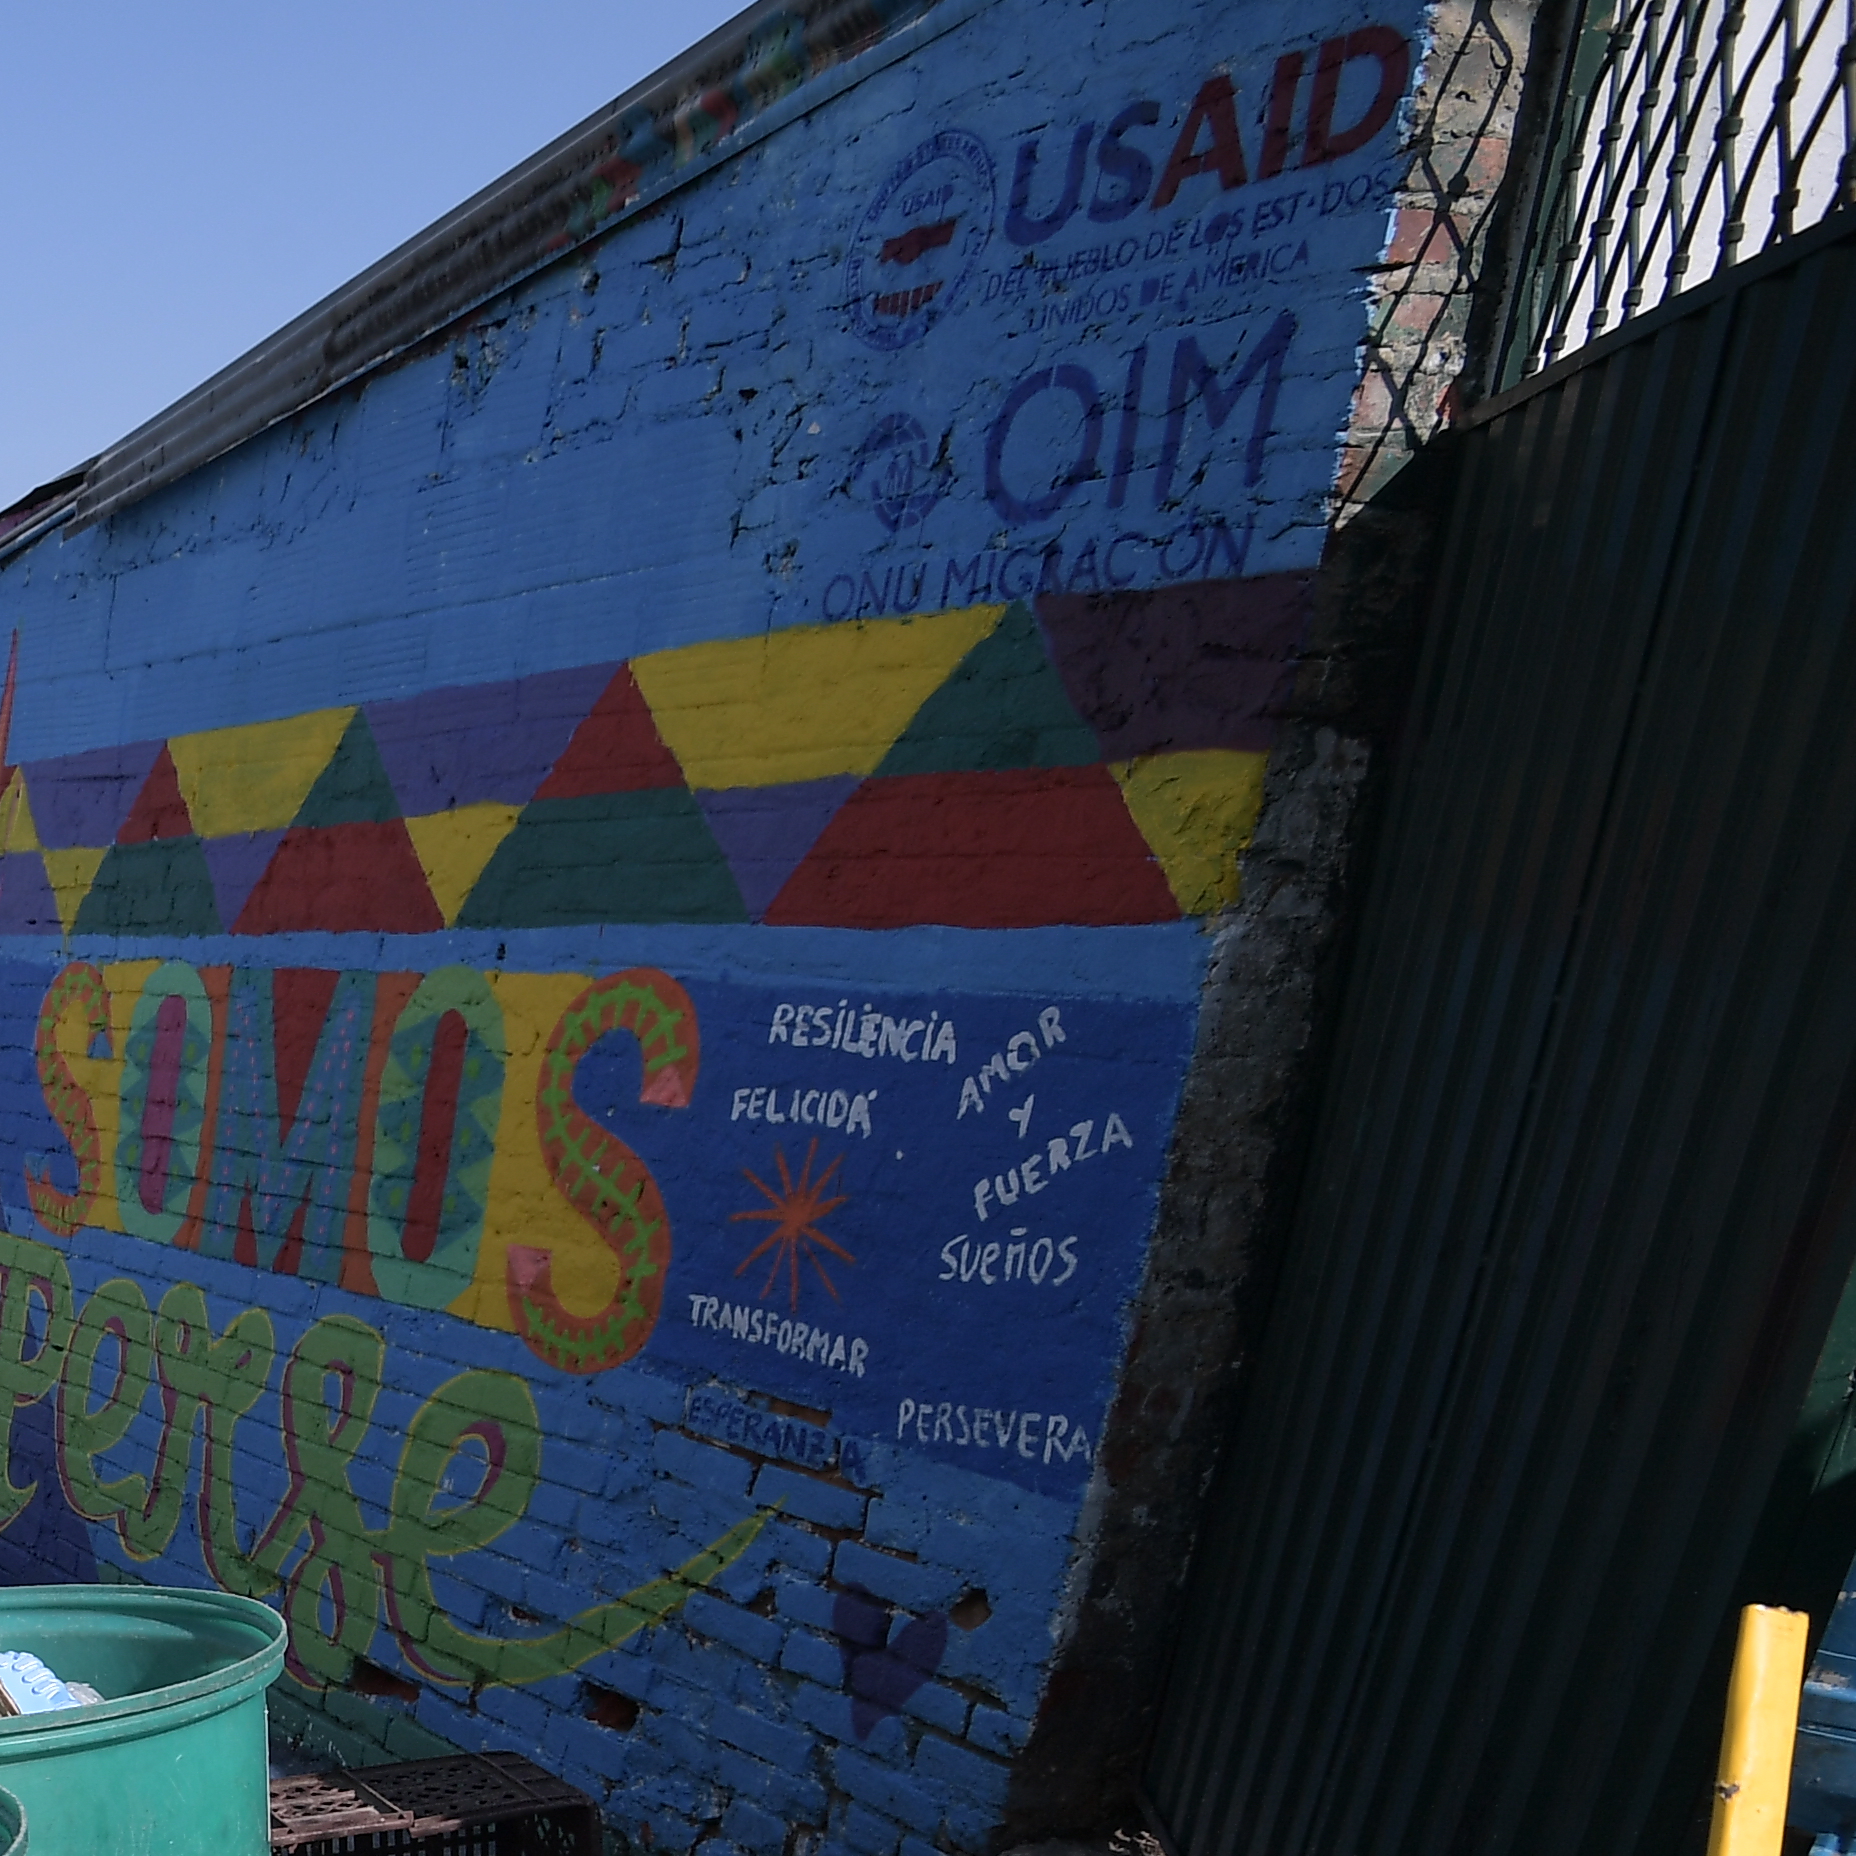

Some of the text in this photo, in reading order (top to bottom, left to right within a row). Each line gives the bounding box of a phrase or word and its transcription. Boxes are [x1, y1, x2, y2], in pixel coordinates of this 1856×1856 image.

[1003, 24, 1412, 247] USAID
[1143, 229, 1184, 260] DE
[1251, 168, 1391, 239] ESTDOS
[1029, 281, 1132, 330] UNIDOS
[985, 312, 1298, 525] OIM
[821, 562, 929, 623] ONU
[957, 1005, 1067, 1120] AMOR
[1008, 1094, 1036, 1138] Y
[26, 957, 700, 1375] SOMOS
[973, 1112, 1134, 1221] FUERZA
[689, 1294, 870, 1377] TRANSFORMAR
[899, 1397, 1094, 1465] PERSEVERA
